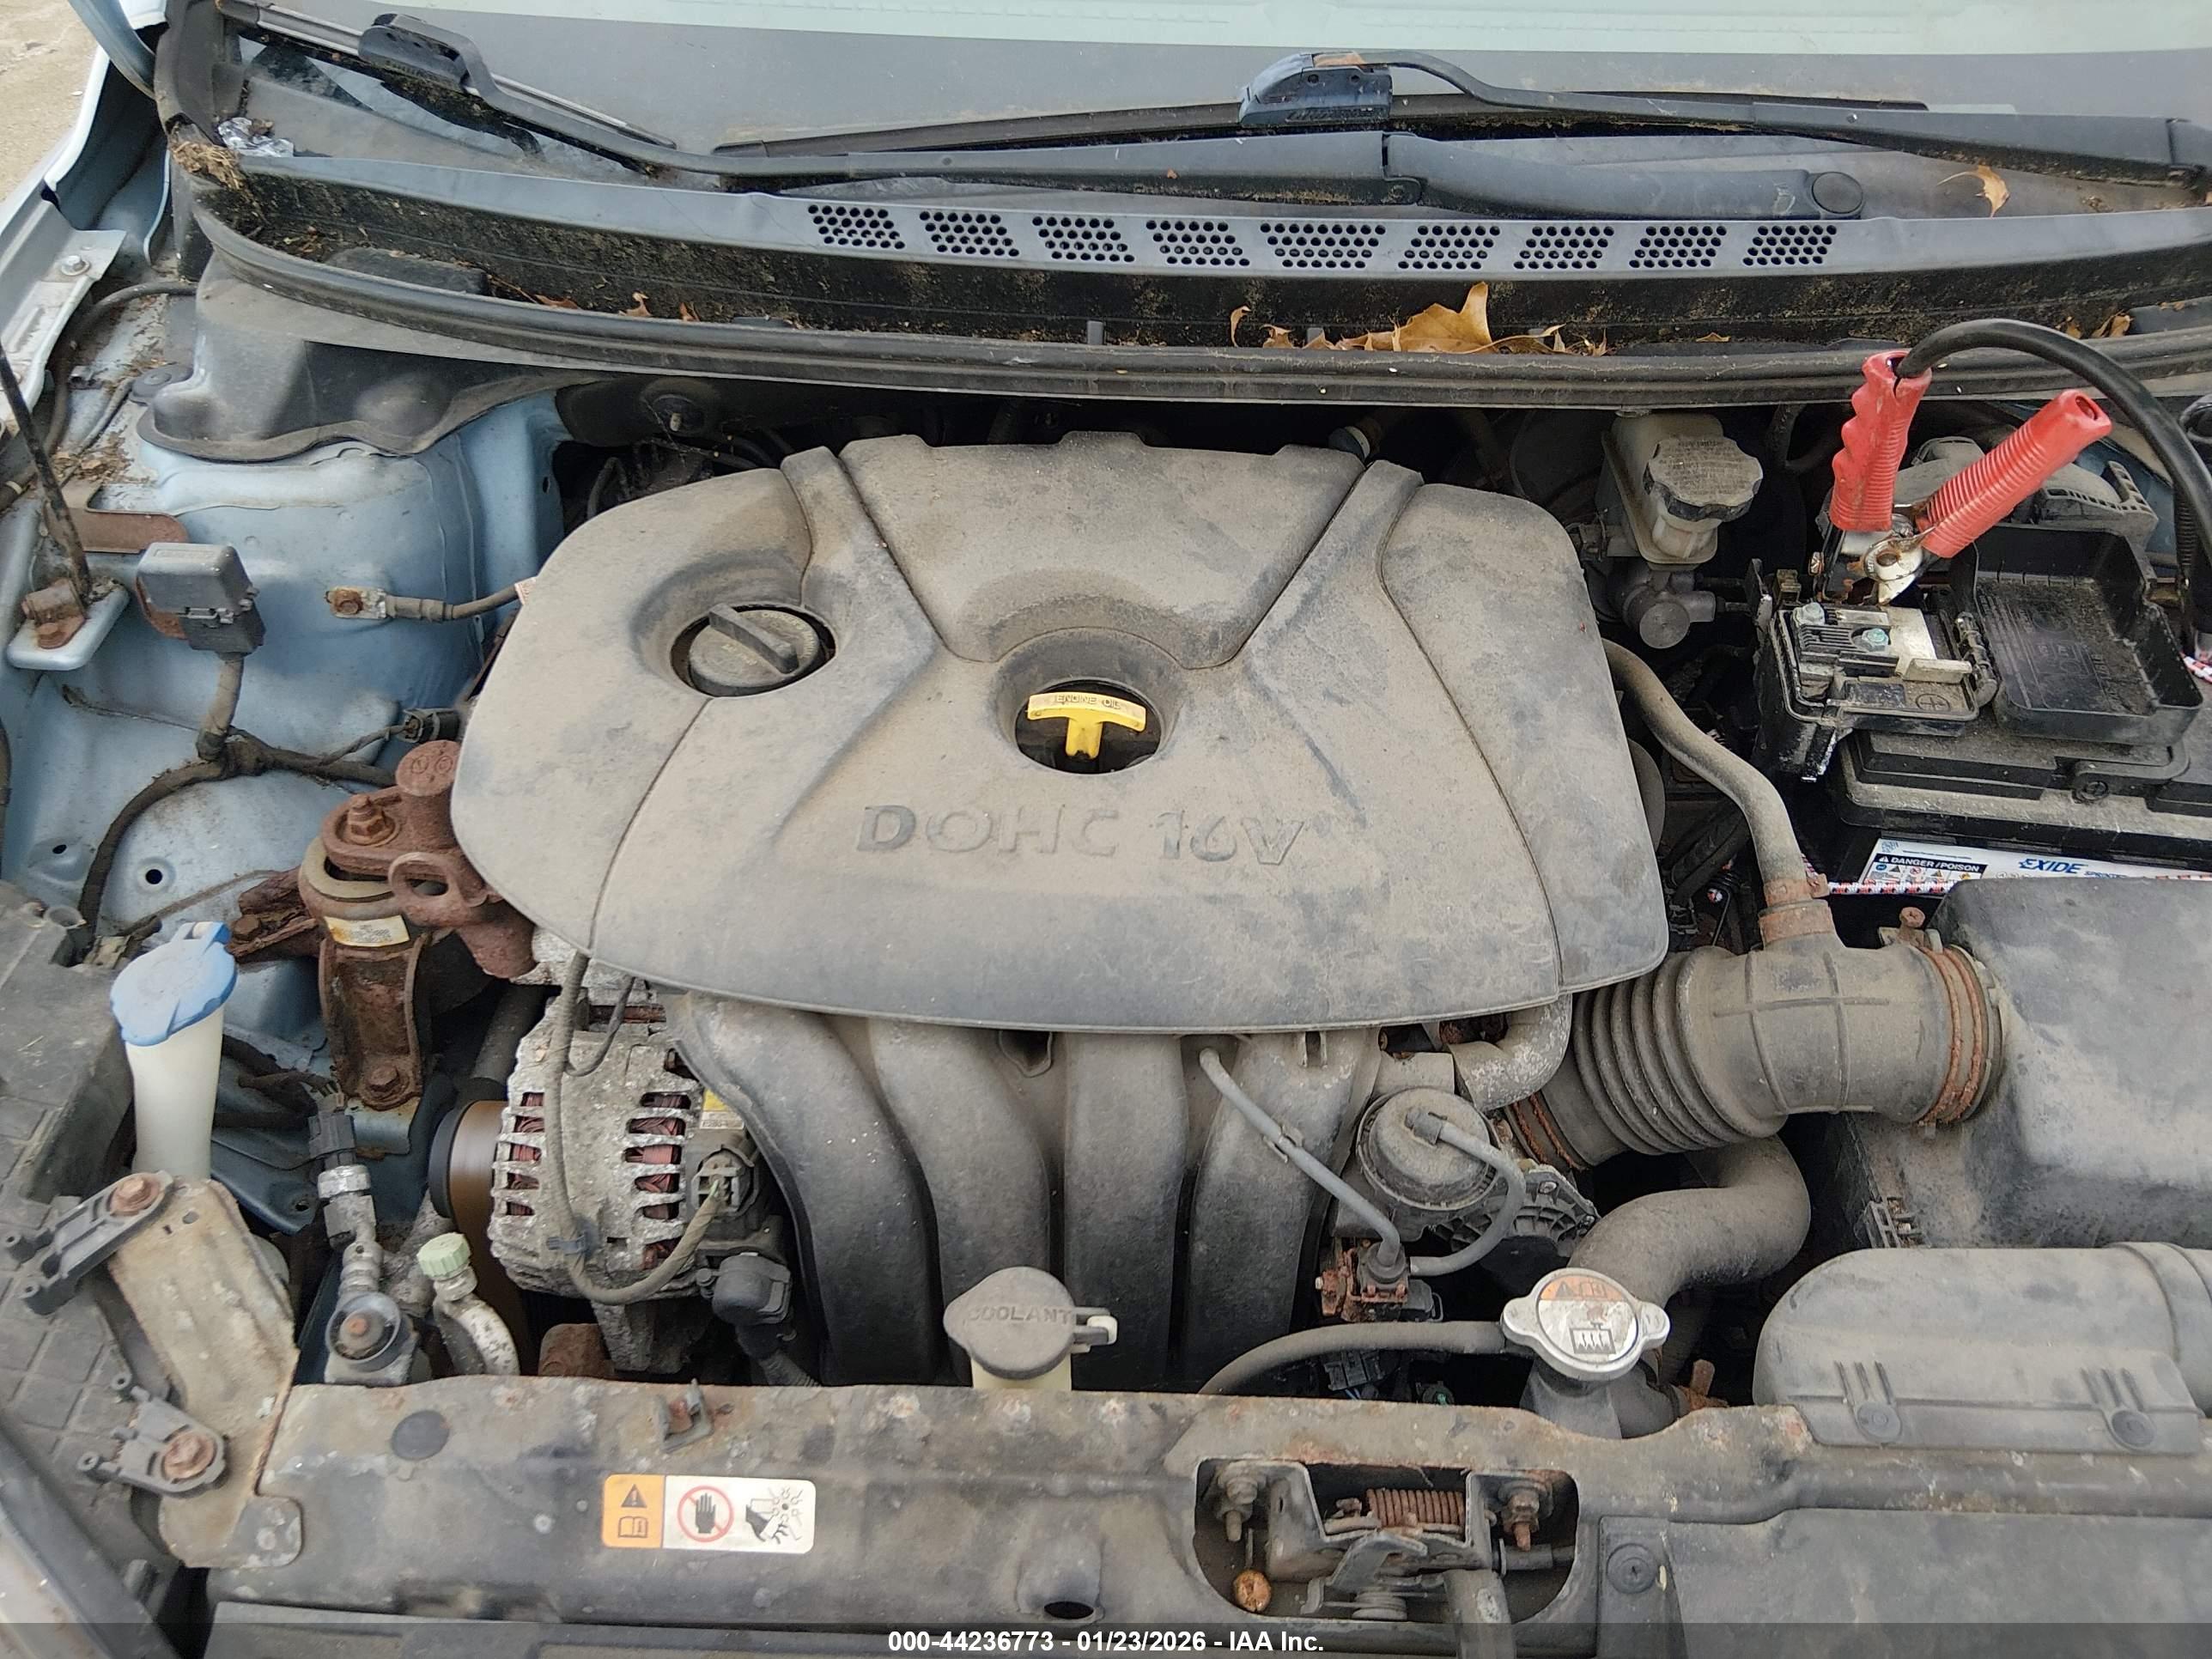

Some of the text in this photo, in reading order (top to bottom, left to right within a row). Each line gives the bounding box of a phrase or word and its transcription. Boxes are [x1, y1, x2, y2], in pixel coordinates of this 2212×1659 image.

[1054, 694, 1121, 709] ENGINE OIL
[857, 804, 1305, 866] DOHC 16V
[2019, 858, 2087, 874] EXIDE
[968, 1306, 1073, 1325] COOLANT
